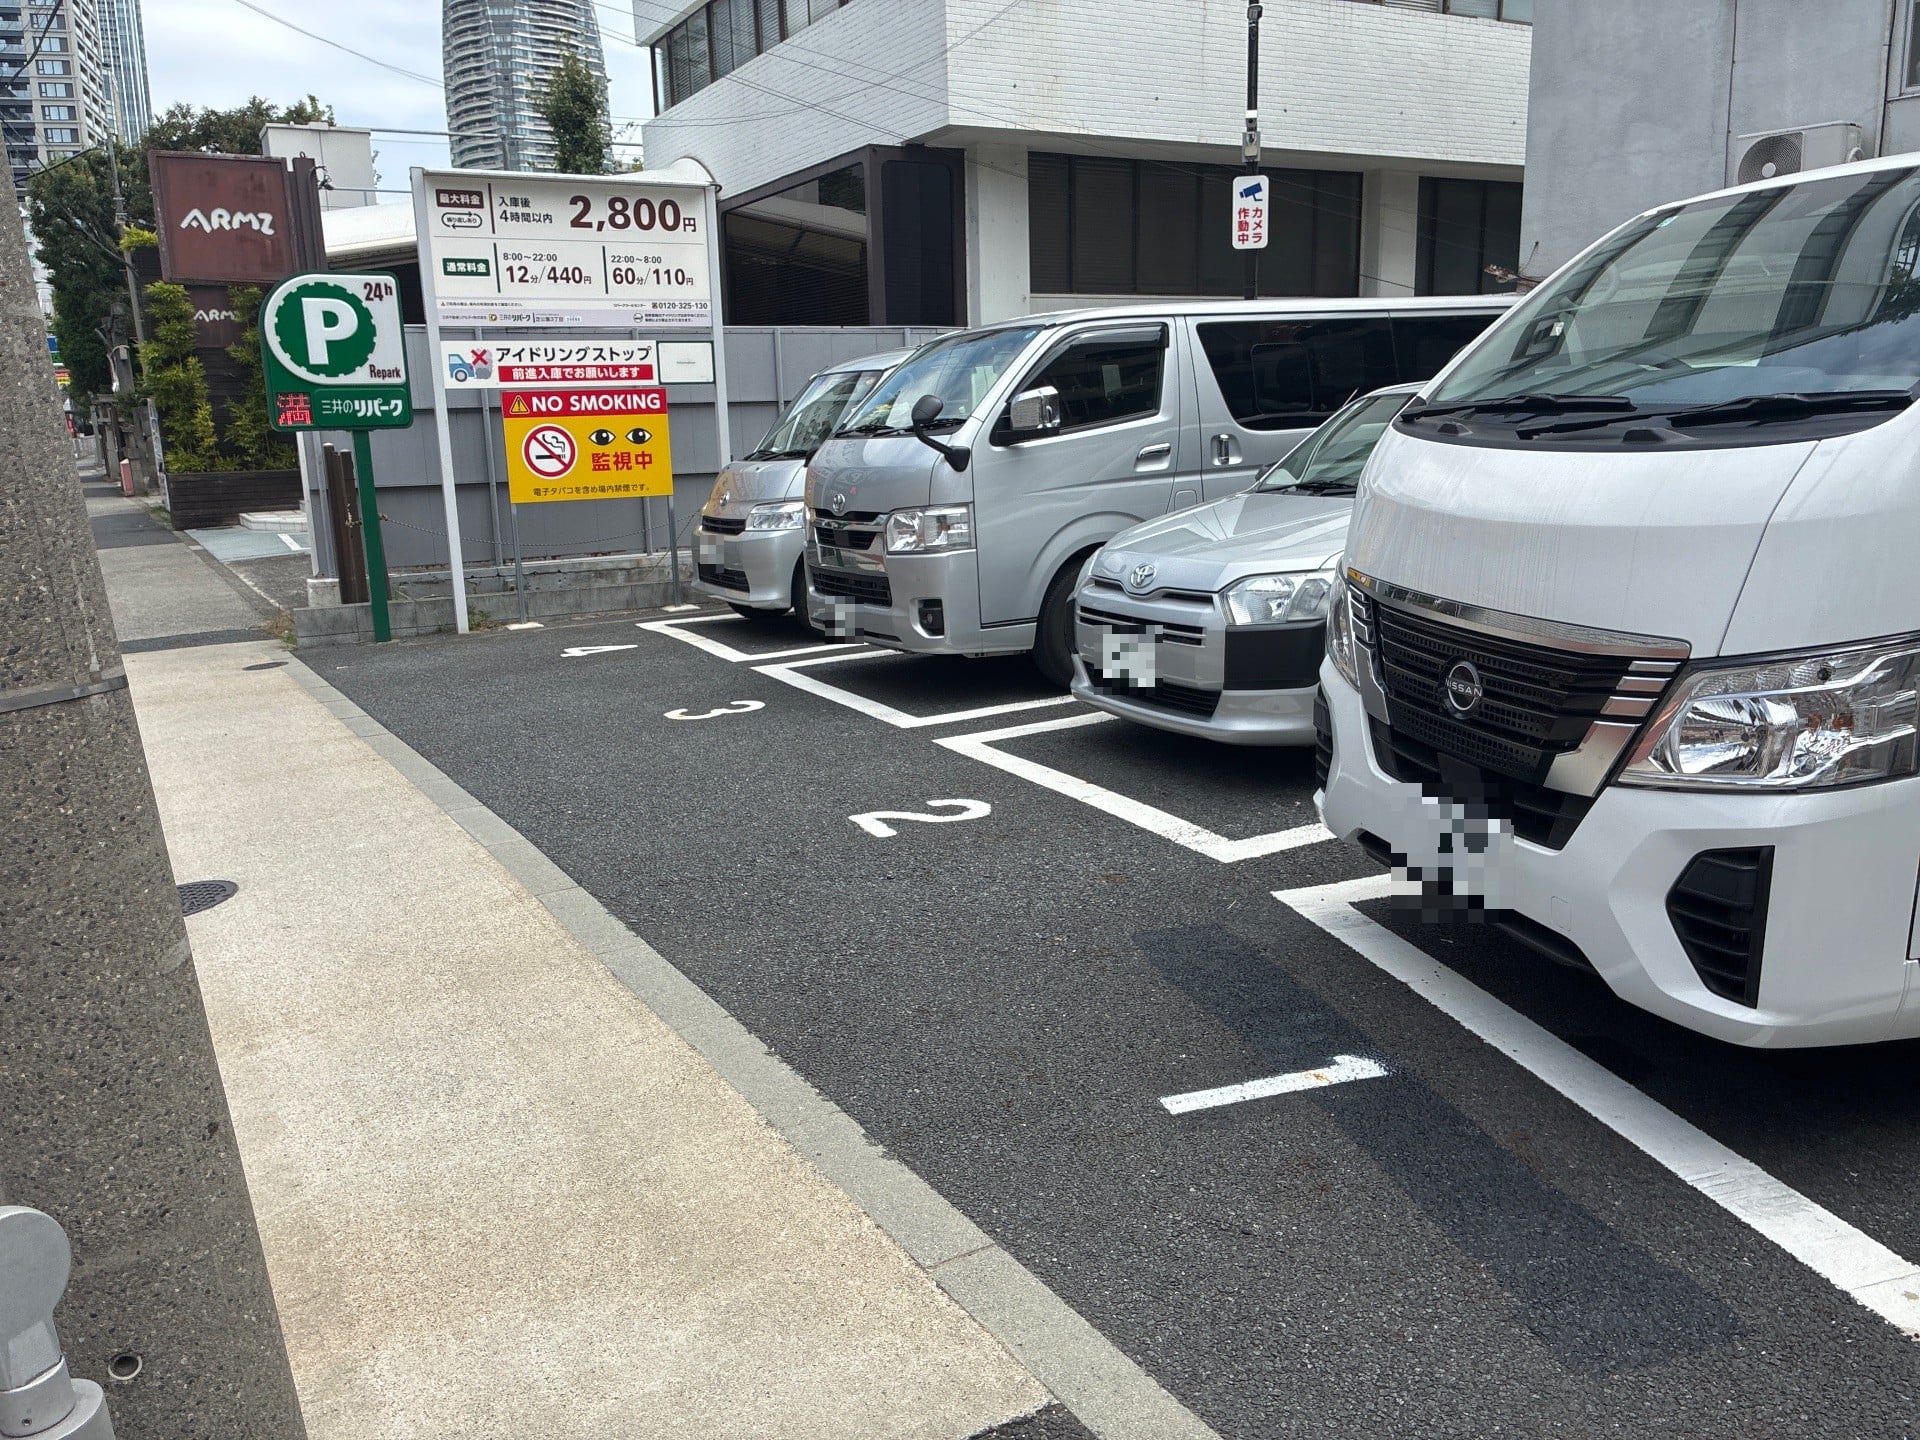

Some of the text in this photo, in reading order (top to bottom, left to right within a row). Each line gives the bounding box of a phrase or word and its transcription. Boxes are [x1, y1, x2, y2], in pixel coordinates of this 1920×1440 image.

[440, 194, 481, 205] 最大料金
[499, 196, 531, 208] 入庫後
[180, 208, 275, 235] ARMZ
[499, 210, 553, 224] 4時間以内
[569, 195, 697, 232] 2,800円
[1237, 207, 1250, 245] 作動中
[1252, 207, 1263, 244] カメラ
[446, 262, 487, 273] 通常料金
[363, 282, 393, 301] 24h
[193, 309, 238, 322] ARM
[659, 302, 708, 310] 0120-325-130
[301, 297, 359, 365] P
[496, 345, 652, 363] アイドリングストップ
[369, 364, 401, 380] Repark
[511, 367, 640, 380] 前進入庫でお願いします
[321, 398, 403, 418] 三井のリパーク
[532, 393, 661, 412] NO SMOKING
[591, 451, 653, 472] 監視中
[533, 483, 650, 497] 電子タバコを含め場内禁煙です。
[560, 644, 638, 658] 4
[1445, 677, 1483, 697] NISSAN
[663, 699, 766, 720] 3
[848, 798, 991, 838] 2
